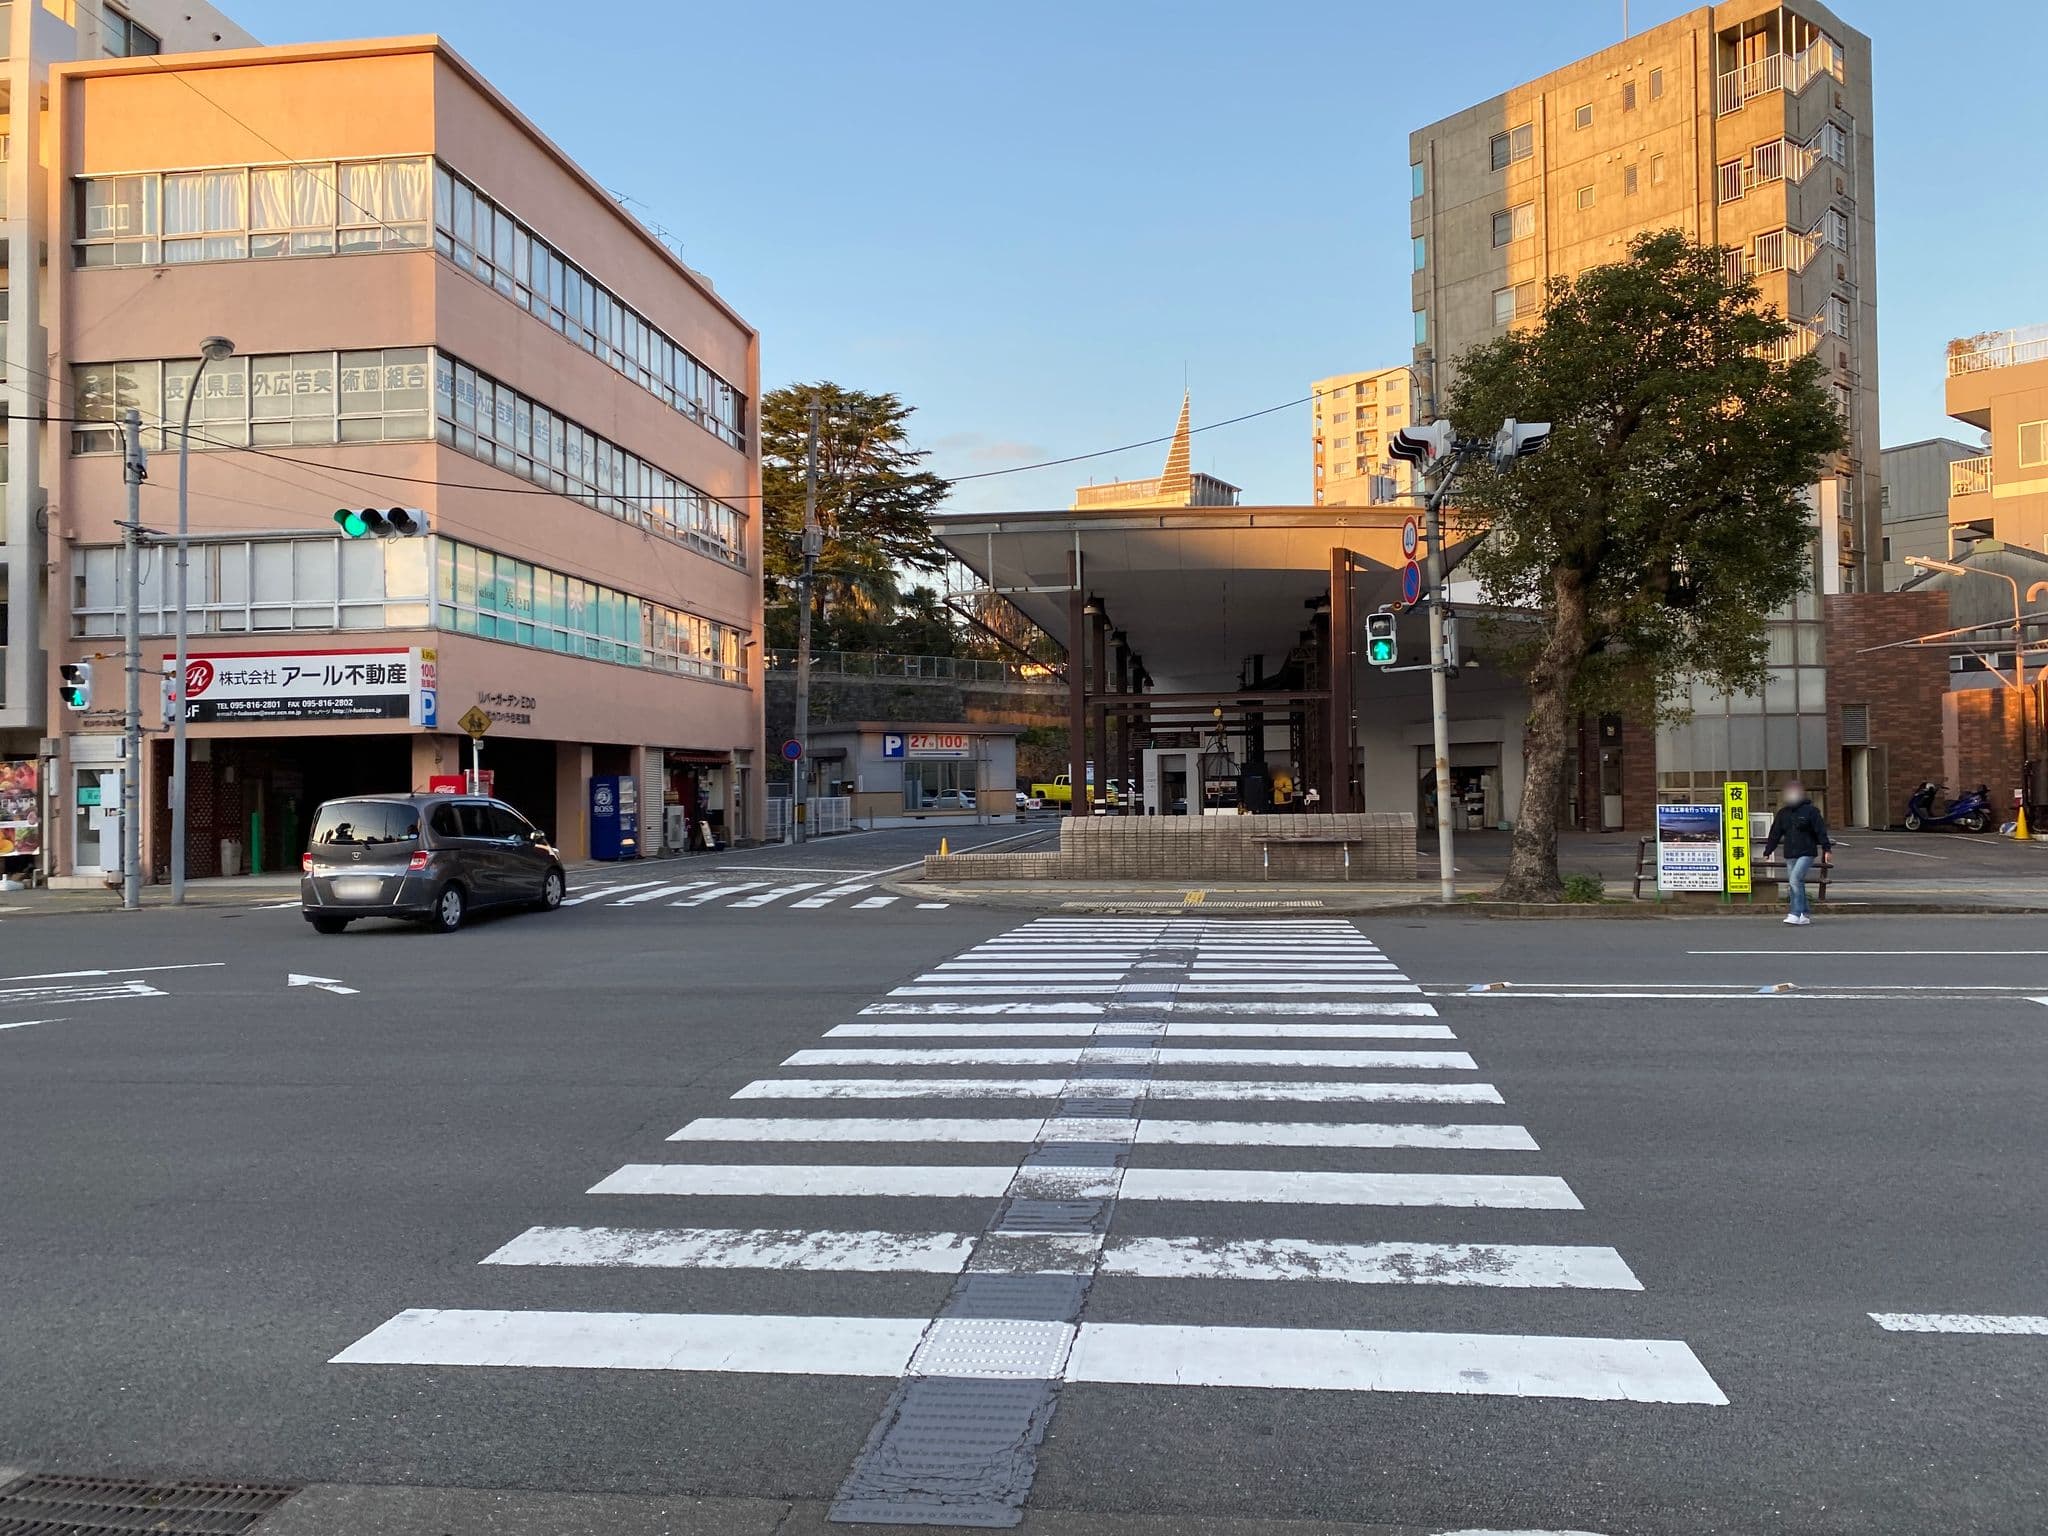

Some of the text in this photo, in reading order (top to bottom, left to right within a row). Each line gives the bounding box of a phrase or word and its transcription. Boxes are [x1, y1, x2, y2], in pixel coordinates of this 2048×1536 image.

[1405, 527, 1415, 546] 40
[218, 663, 407, 687] 株式会社 アール不動産
[230, 701, 281, 709] 095-816-2801
[302, 699, 353, 708] 095-816-2802
[421, 691, 436, 725] P
[885, 735, 902, 755] P
[593, 805, 614, 813] BOSS
[1730, 786, 1746, 880] 夜間工事中
